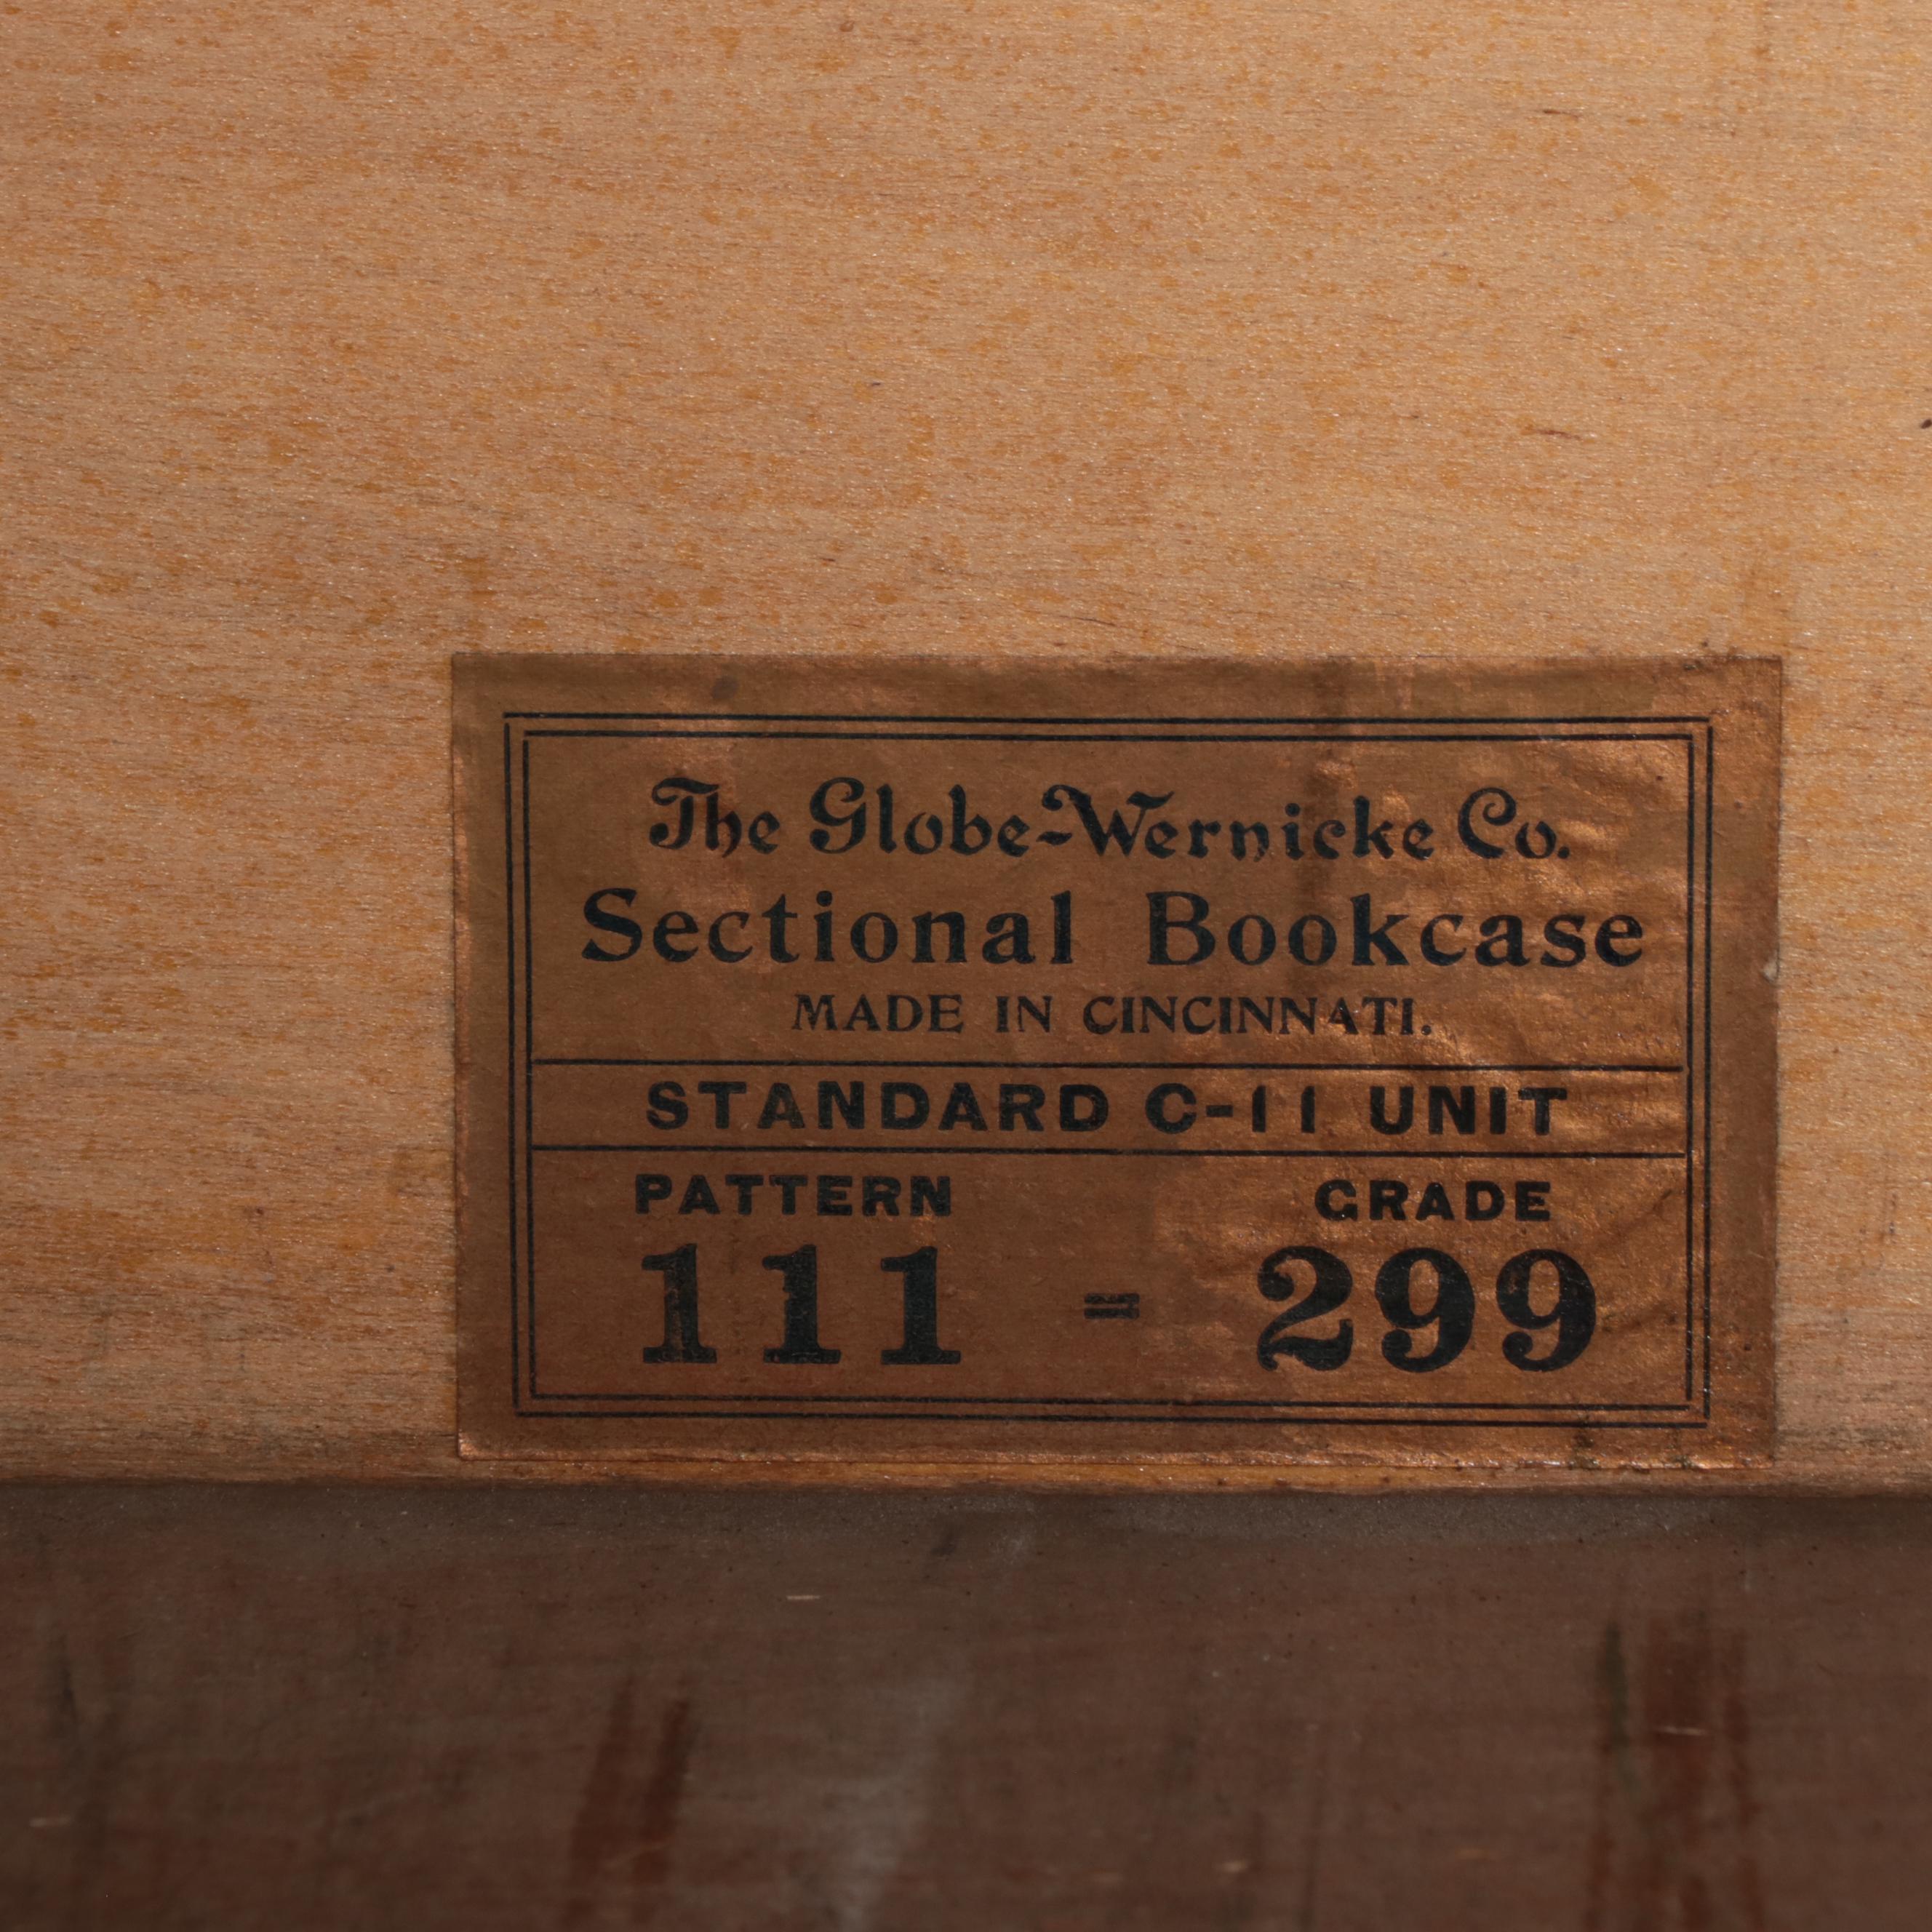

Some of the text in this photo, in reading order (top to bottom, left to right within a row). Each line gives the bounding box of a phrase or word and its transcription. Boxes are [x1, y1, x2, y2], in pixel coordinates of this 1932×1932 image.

[649, 777, 1570, 862] The Globe-Wernicke Co.
[582, 888, 1643, 968] Sectional Bookcase
[791, 994, 1432, 1036] MADE IN CINCINNATI.
[646, 1081, 1109, 1133] STANDARD
[1369, 1085, 1568, 1135] UNIT
[635, 1173, 1551, 1221] PATTERN GRADE
[641, 1243, 962, 1365] 111
[1257, 1246, 1597, 1373] 299
